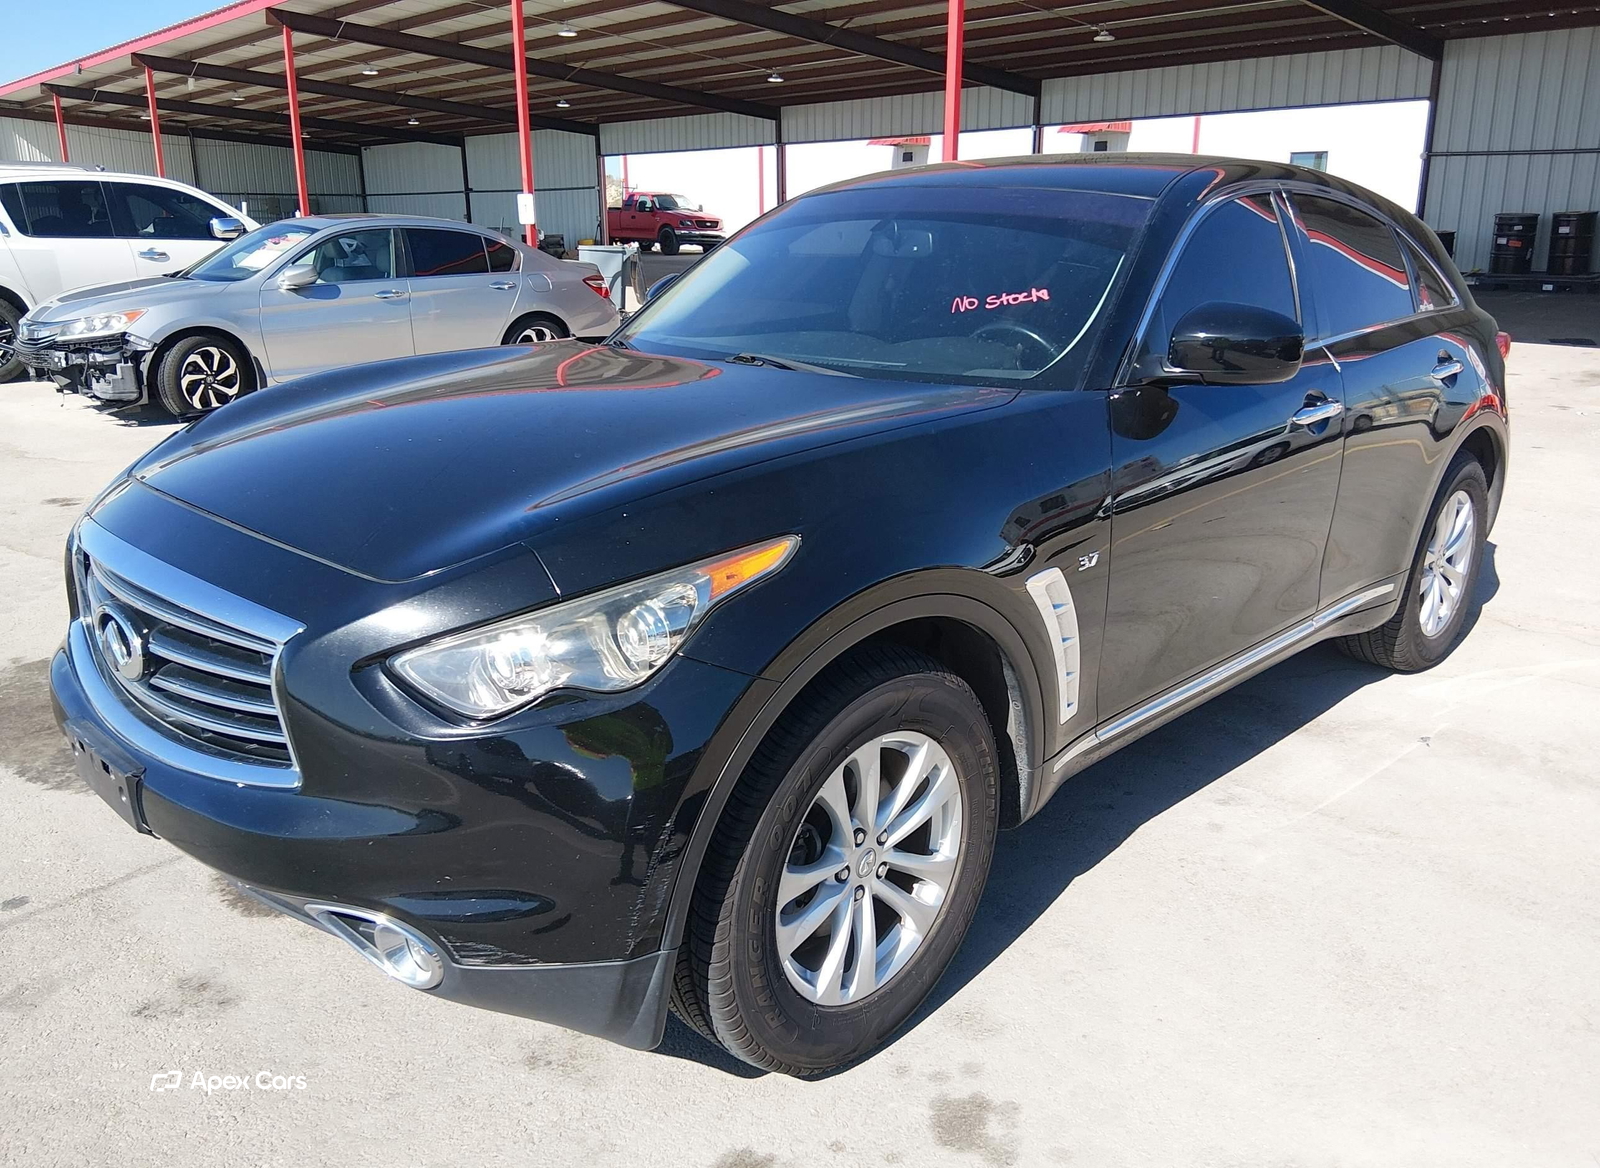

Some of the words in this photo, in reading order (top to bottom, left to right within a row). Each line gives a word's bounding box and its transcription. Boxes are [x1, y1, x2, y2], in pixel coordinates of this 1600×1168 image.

[1078, 551, 1100, 571] 37
[749, 876, 787, 1031] RANGER
[769, 766, 812, 851] 007
